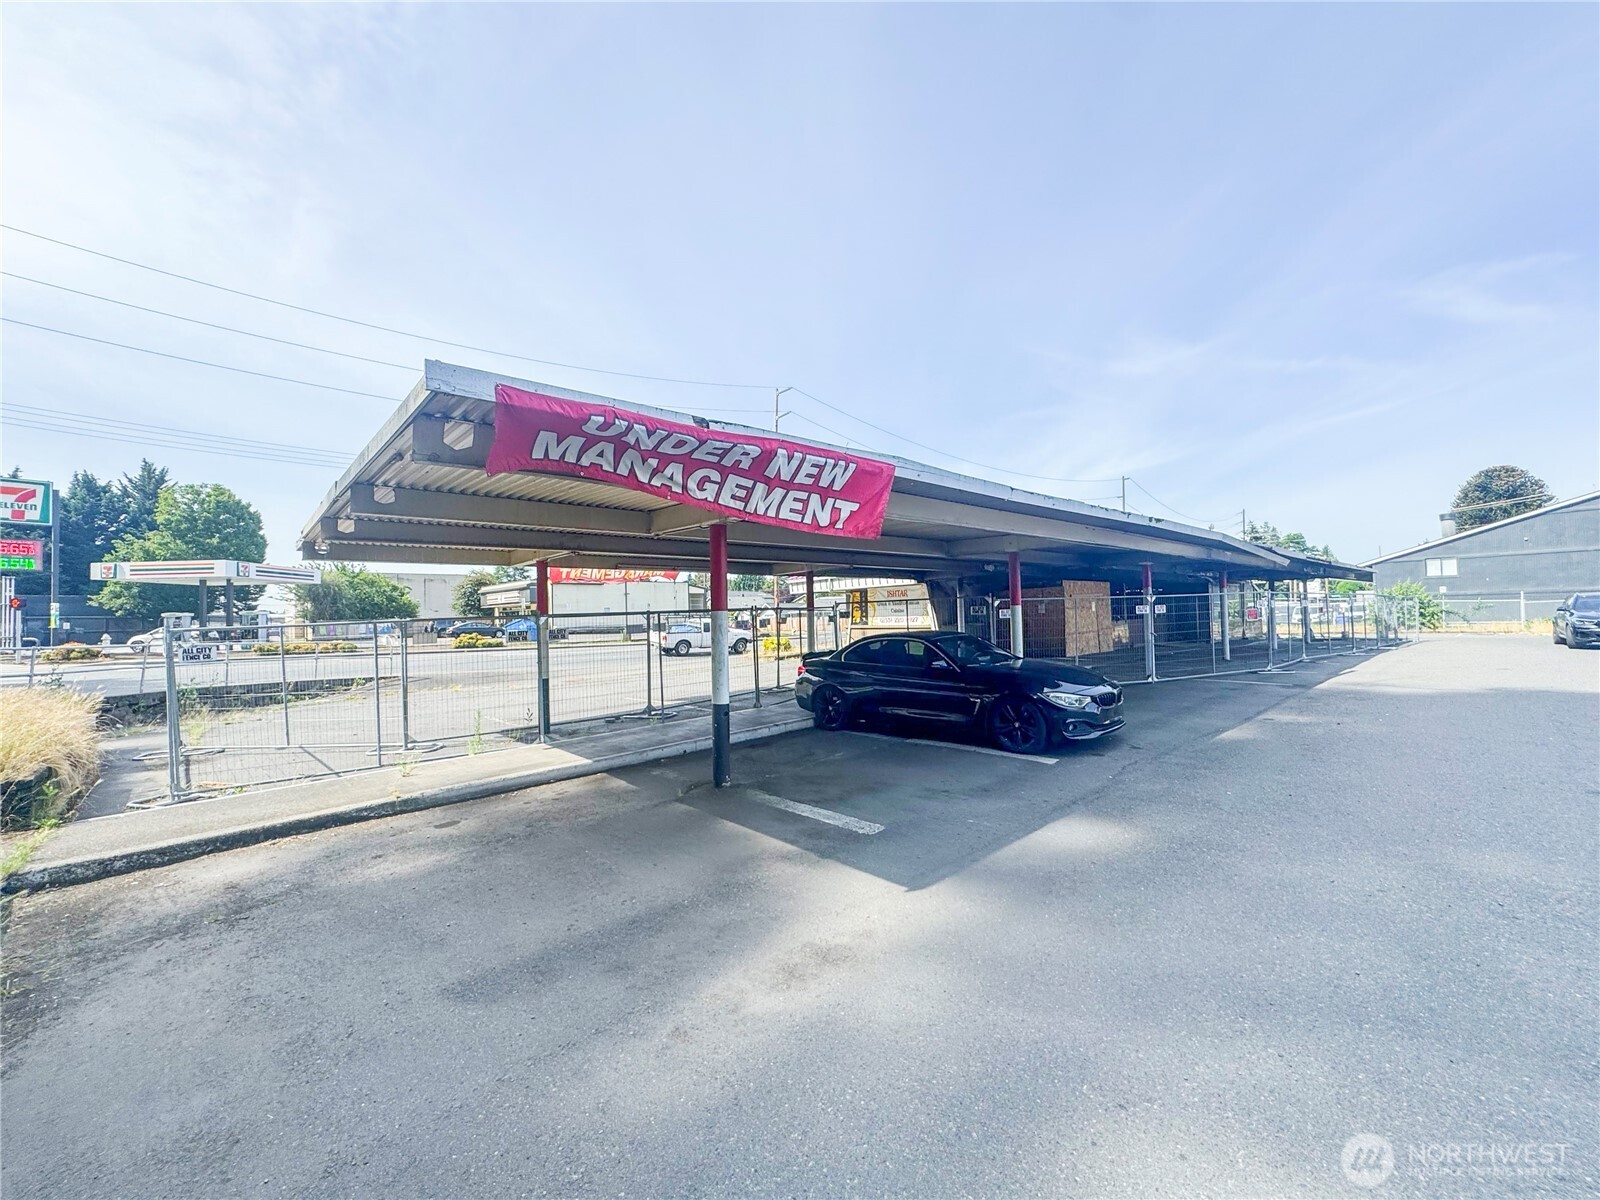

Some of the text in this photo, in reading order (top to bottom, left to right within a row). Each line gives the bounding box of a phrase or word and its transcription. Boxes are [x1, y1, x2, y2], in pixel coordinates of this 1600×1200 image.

[581, 414, 857, 492] UNDER NEW
[531, 430, 861, 530] MANAGEMENT
[887, 589, 909, 598] ISHTAR
[196, 646, 213, 654] CITY
